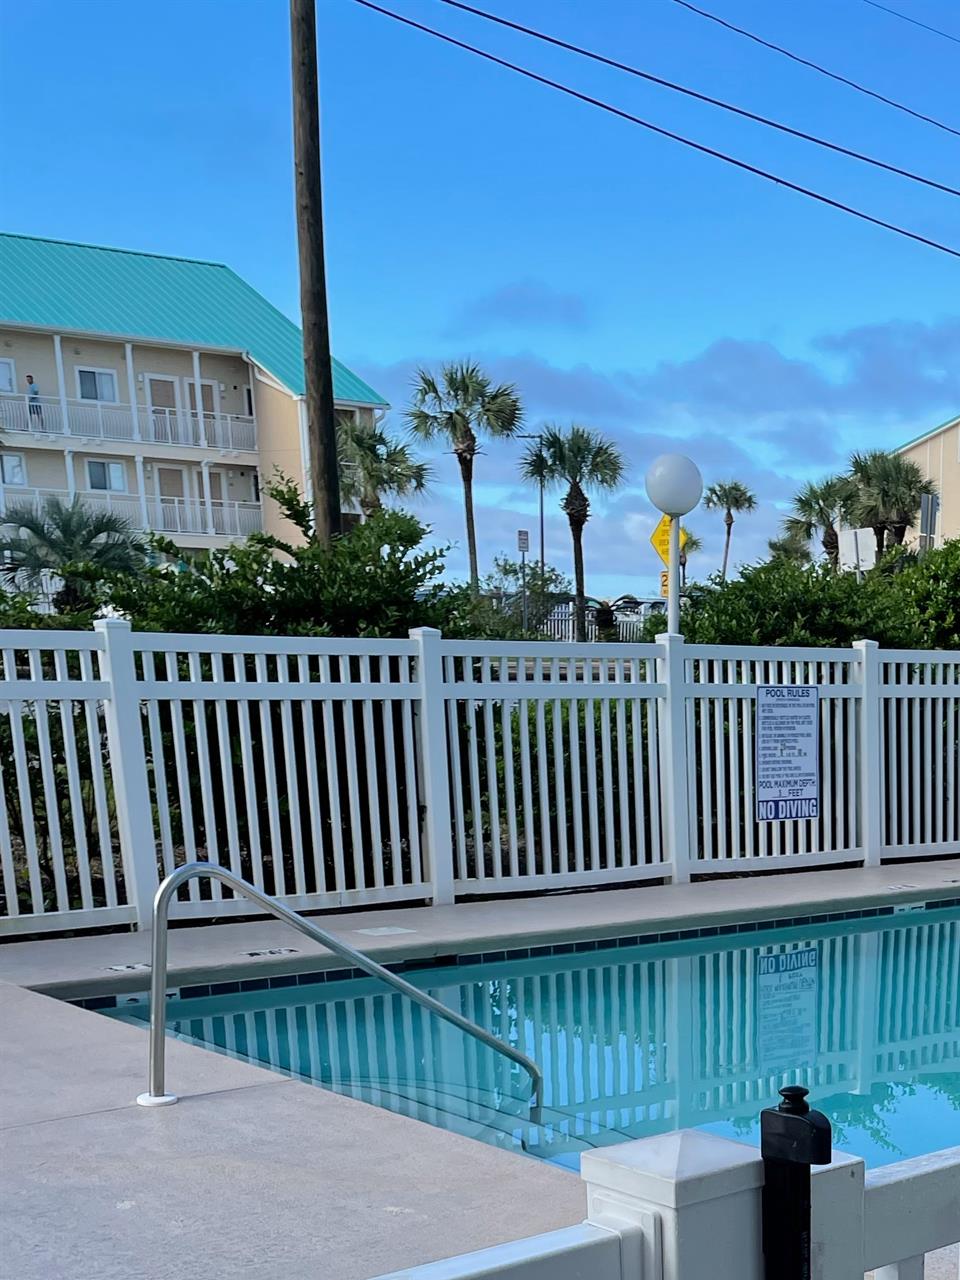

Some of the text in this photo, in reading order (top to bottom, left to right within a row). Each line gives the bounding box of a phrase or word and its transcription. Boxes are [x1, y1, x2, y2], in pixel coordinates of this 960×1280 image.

[765, 689, 810, 698] POOL RULES
[759, 780, 773, 789] POOL
[774, 779, 798, 788] MAXIMUM
[788, 788, 804, 797] FEET
[759, 799, 817, 819] NO DIVING
